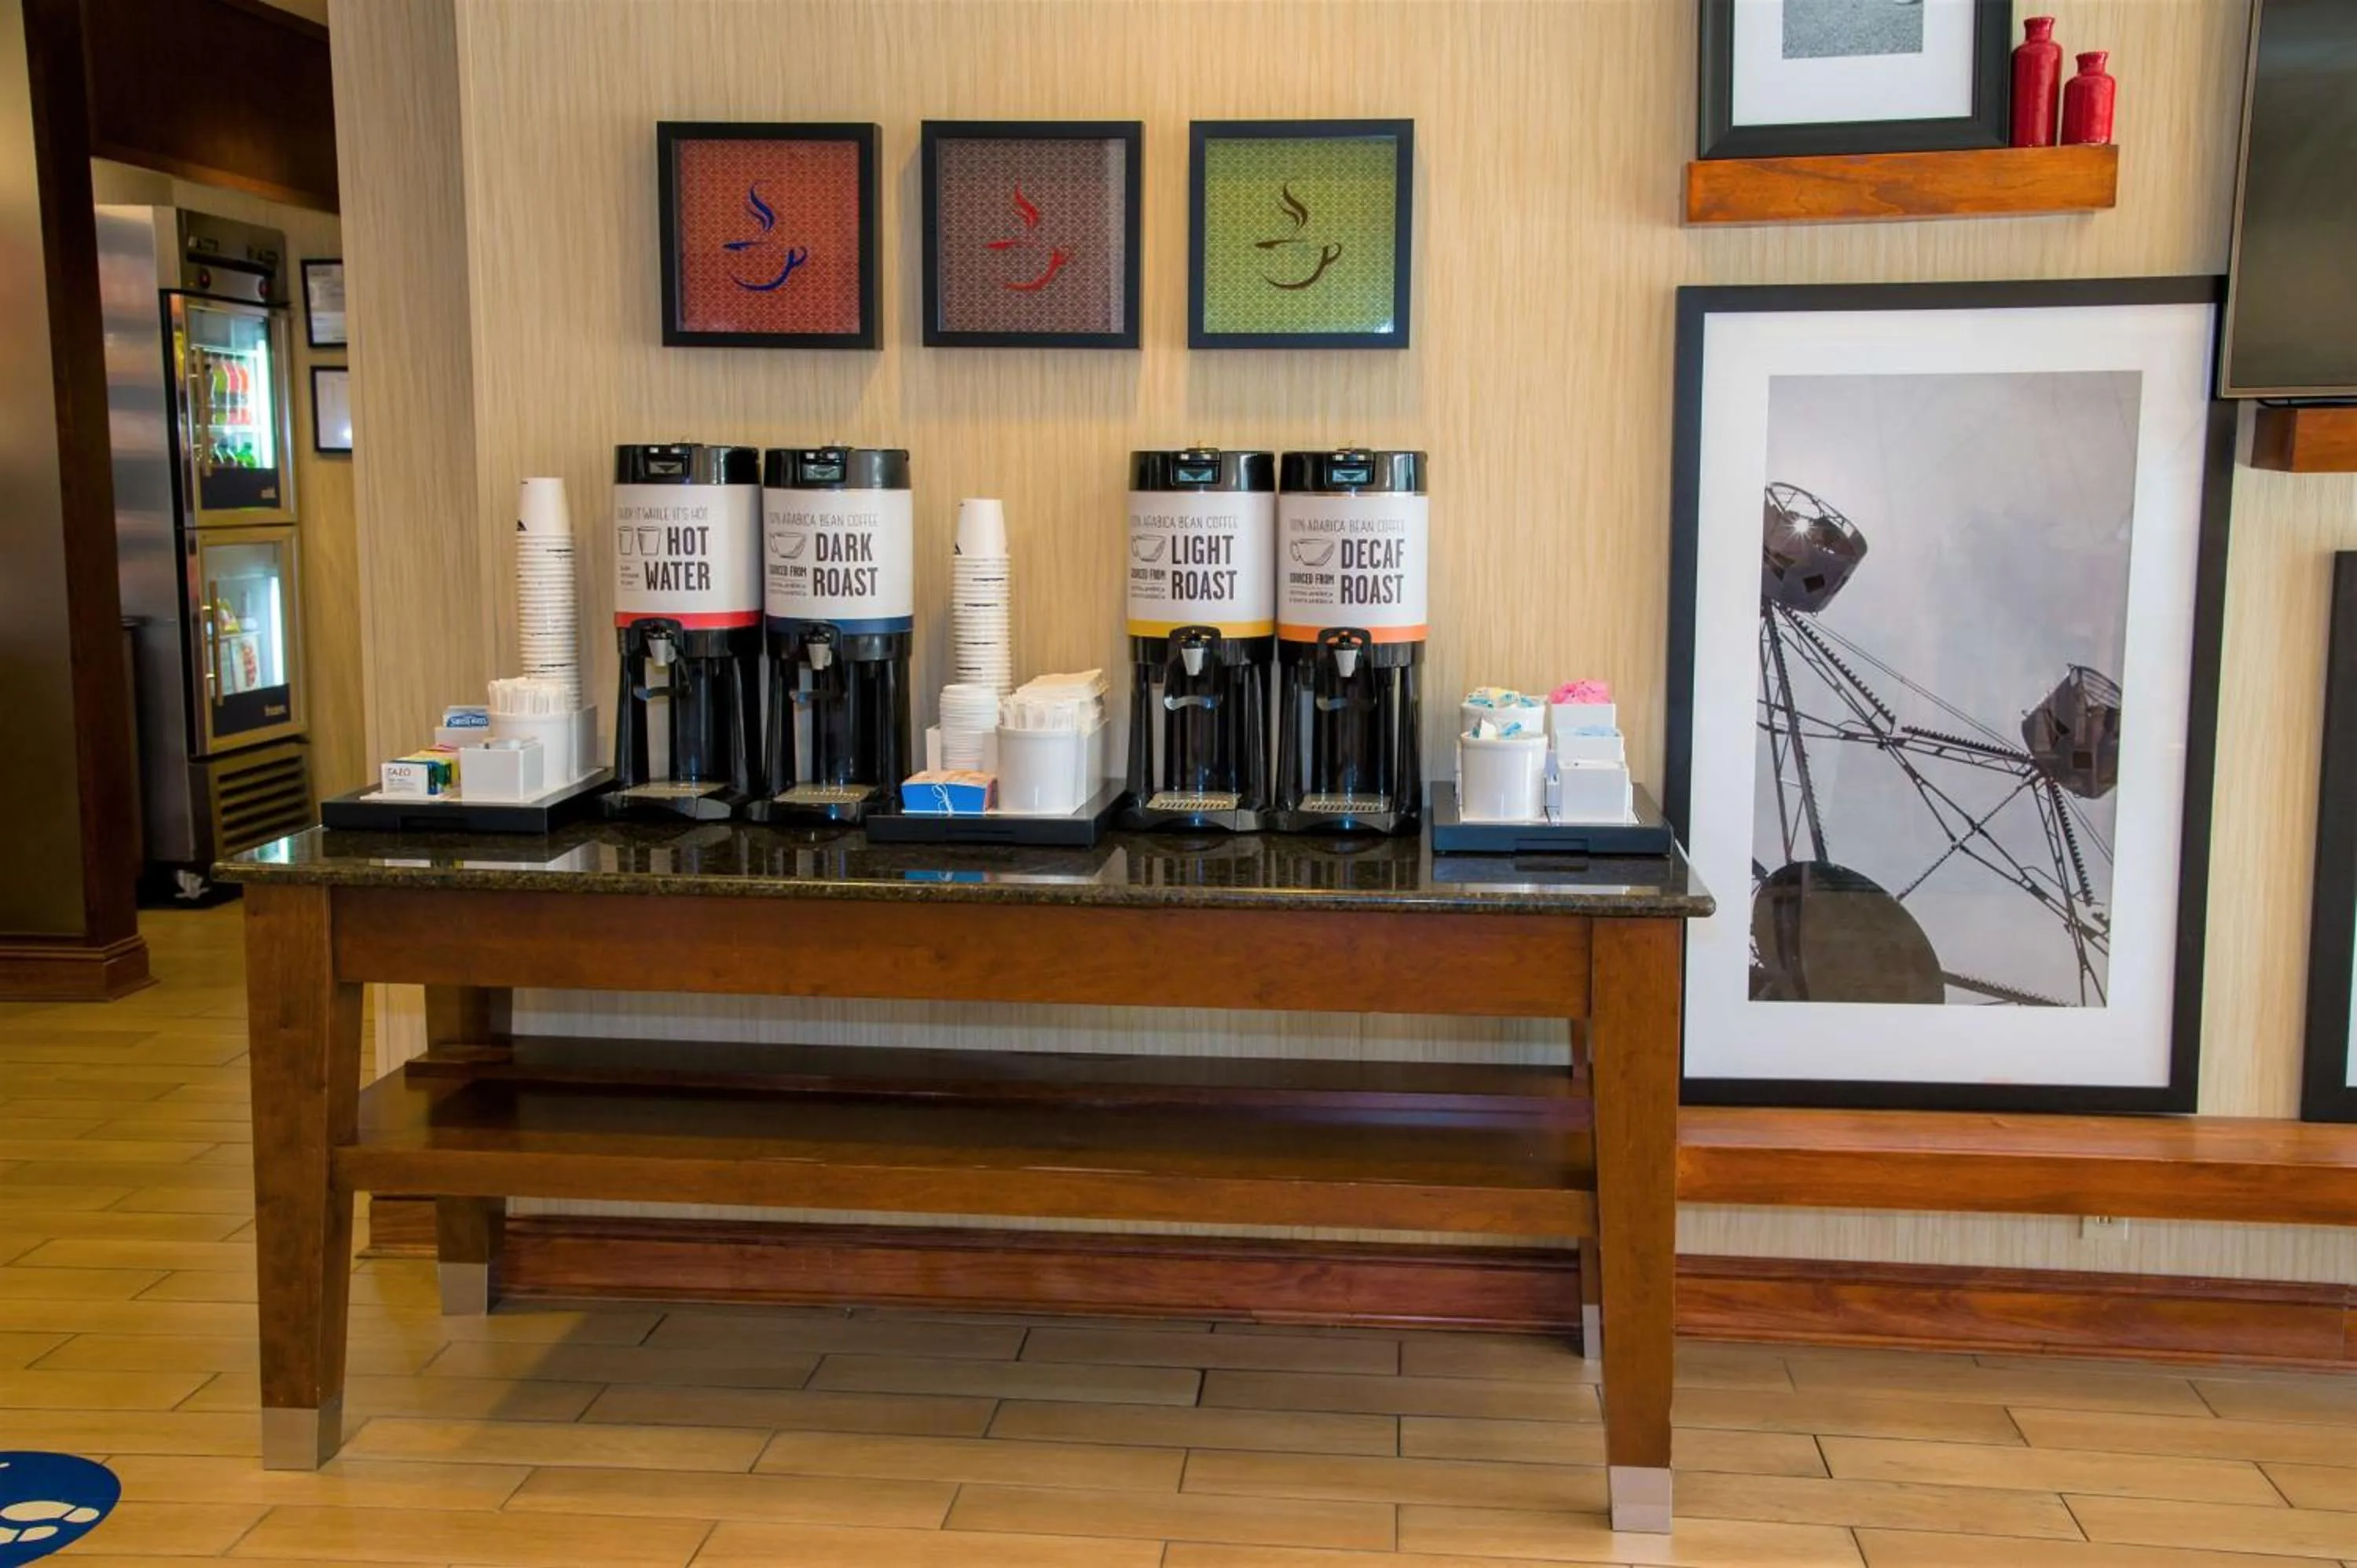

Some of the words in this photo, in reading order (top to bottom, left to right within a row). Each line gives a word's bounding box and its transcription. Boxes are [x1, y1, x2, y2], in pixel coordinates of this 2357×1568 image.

[643, 507, 669, 521] WHILE
[691, 506, 709, 520] HOT
[819, 514, 844, 527] BEAN
[847, 513, 879, 527] COFFEE
[1178, 515, 1203, 529] BEAN
[1206, 515, 1239, 529] COFFEE
[1349, 519, 1374, 533] BEAN
[667, 526, 709, 555] HOT
[816, 532, 873, 562] DARK
[1171, 535, 1234, 565] LIGHT
[1340, 538, 1405, 569] DECAF
[644, 561, 711, 591] WATER
[790, 566, 807, 577] FROM
[813, 567, 878, 596] ROAST
[1171, 570, 1237, 600] ROAST
[1315, 573, 1335, 585] FROM
[1340, 574, 1405, 604] ROAST
